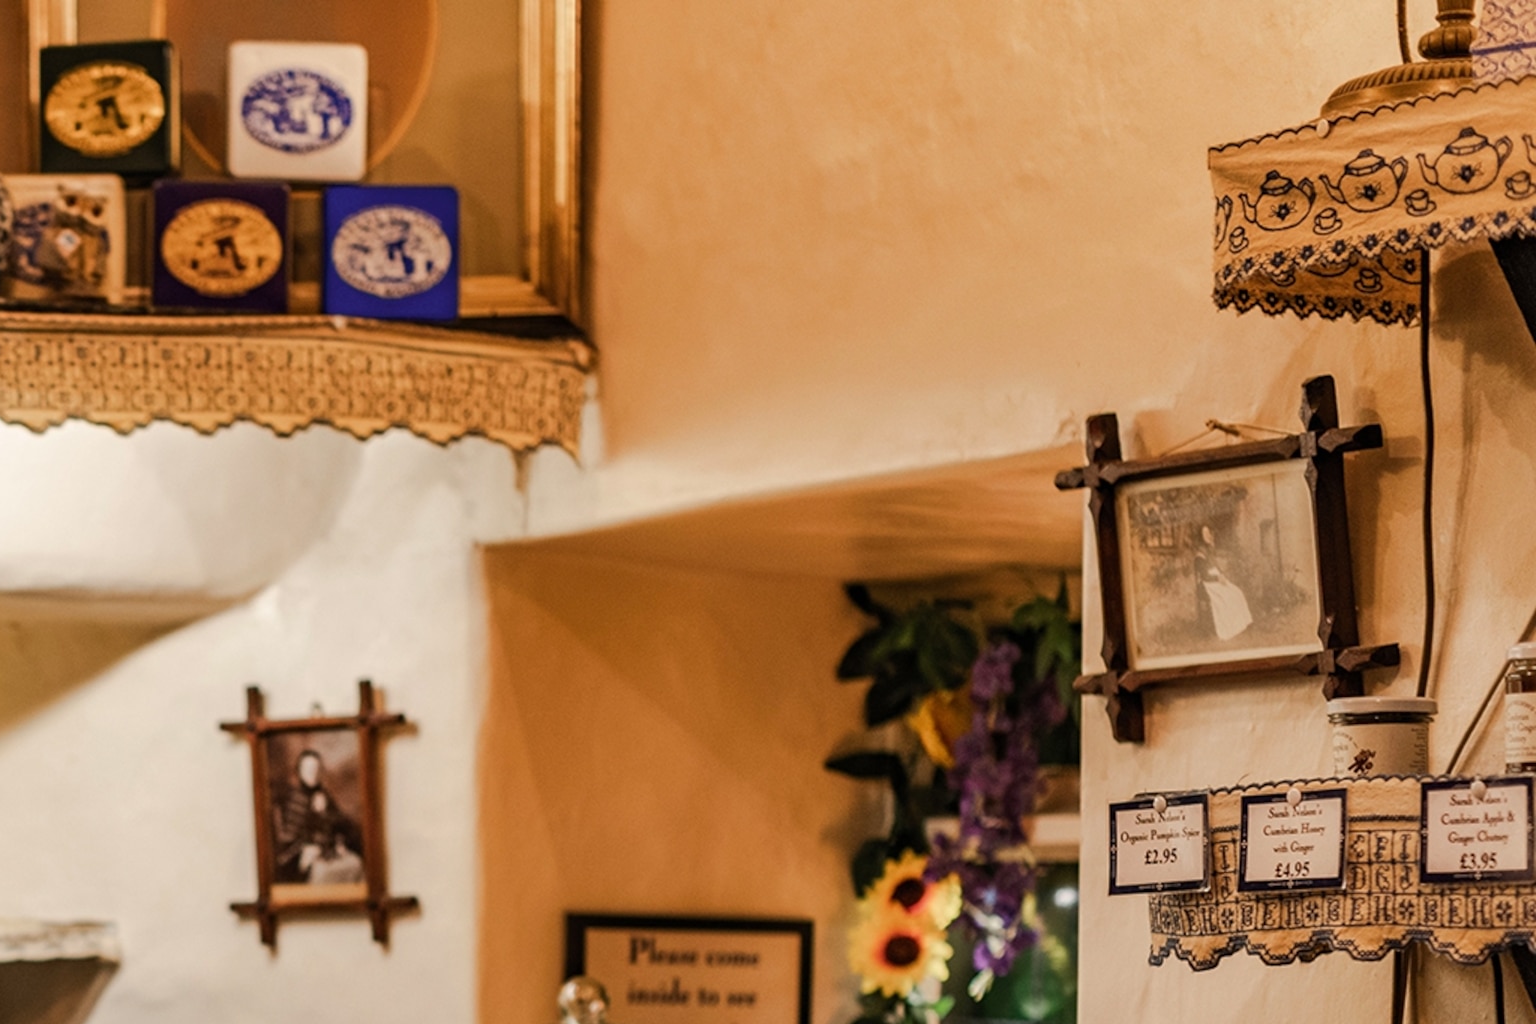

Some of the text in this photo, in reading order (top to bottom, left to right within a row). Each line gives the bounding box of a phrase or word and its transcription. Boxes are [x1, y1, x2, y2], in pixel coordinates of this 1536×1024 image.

[1476, 791, 1507, 806] elson's
[1144, 847, 1178, 865] £2.95
[1459, 852, 1497, 870] £3.95
[1274, 861, 1310, 878] £4.95
[628, 935, 759, 966] Please come
[627, 976, 756, 1005] inside to see
